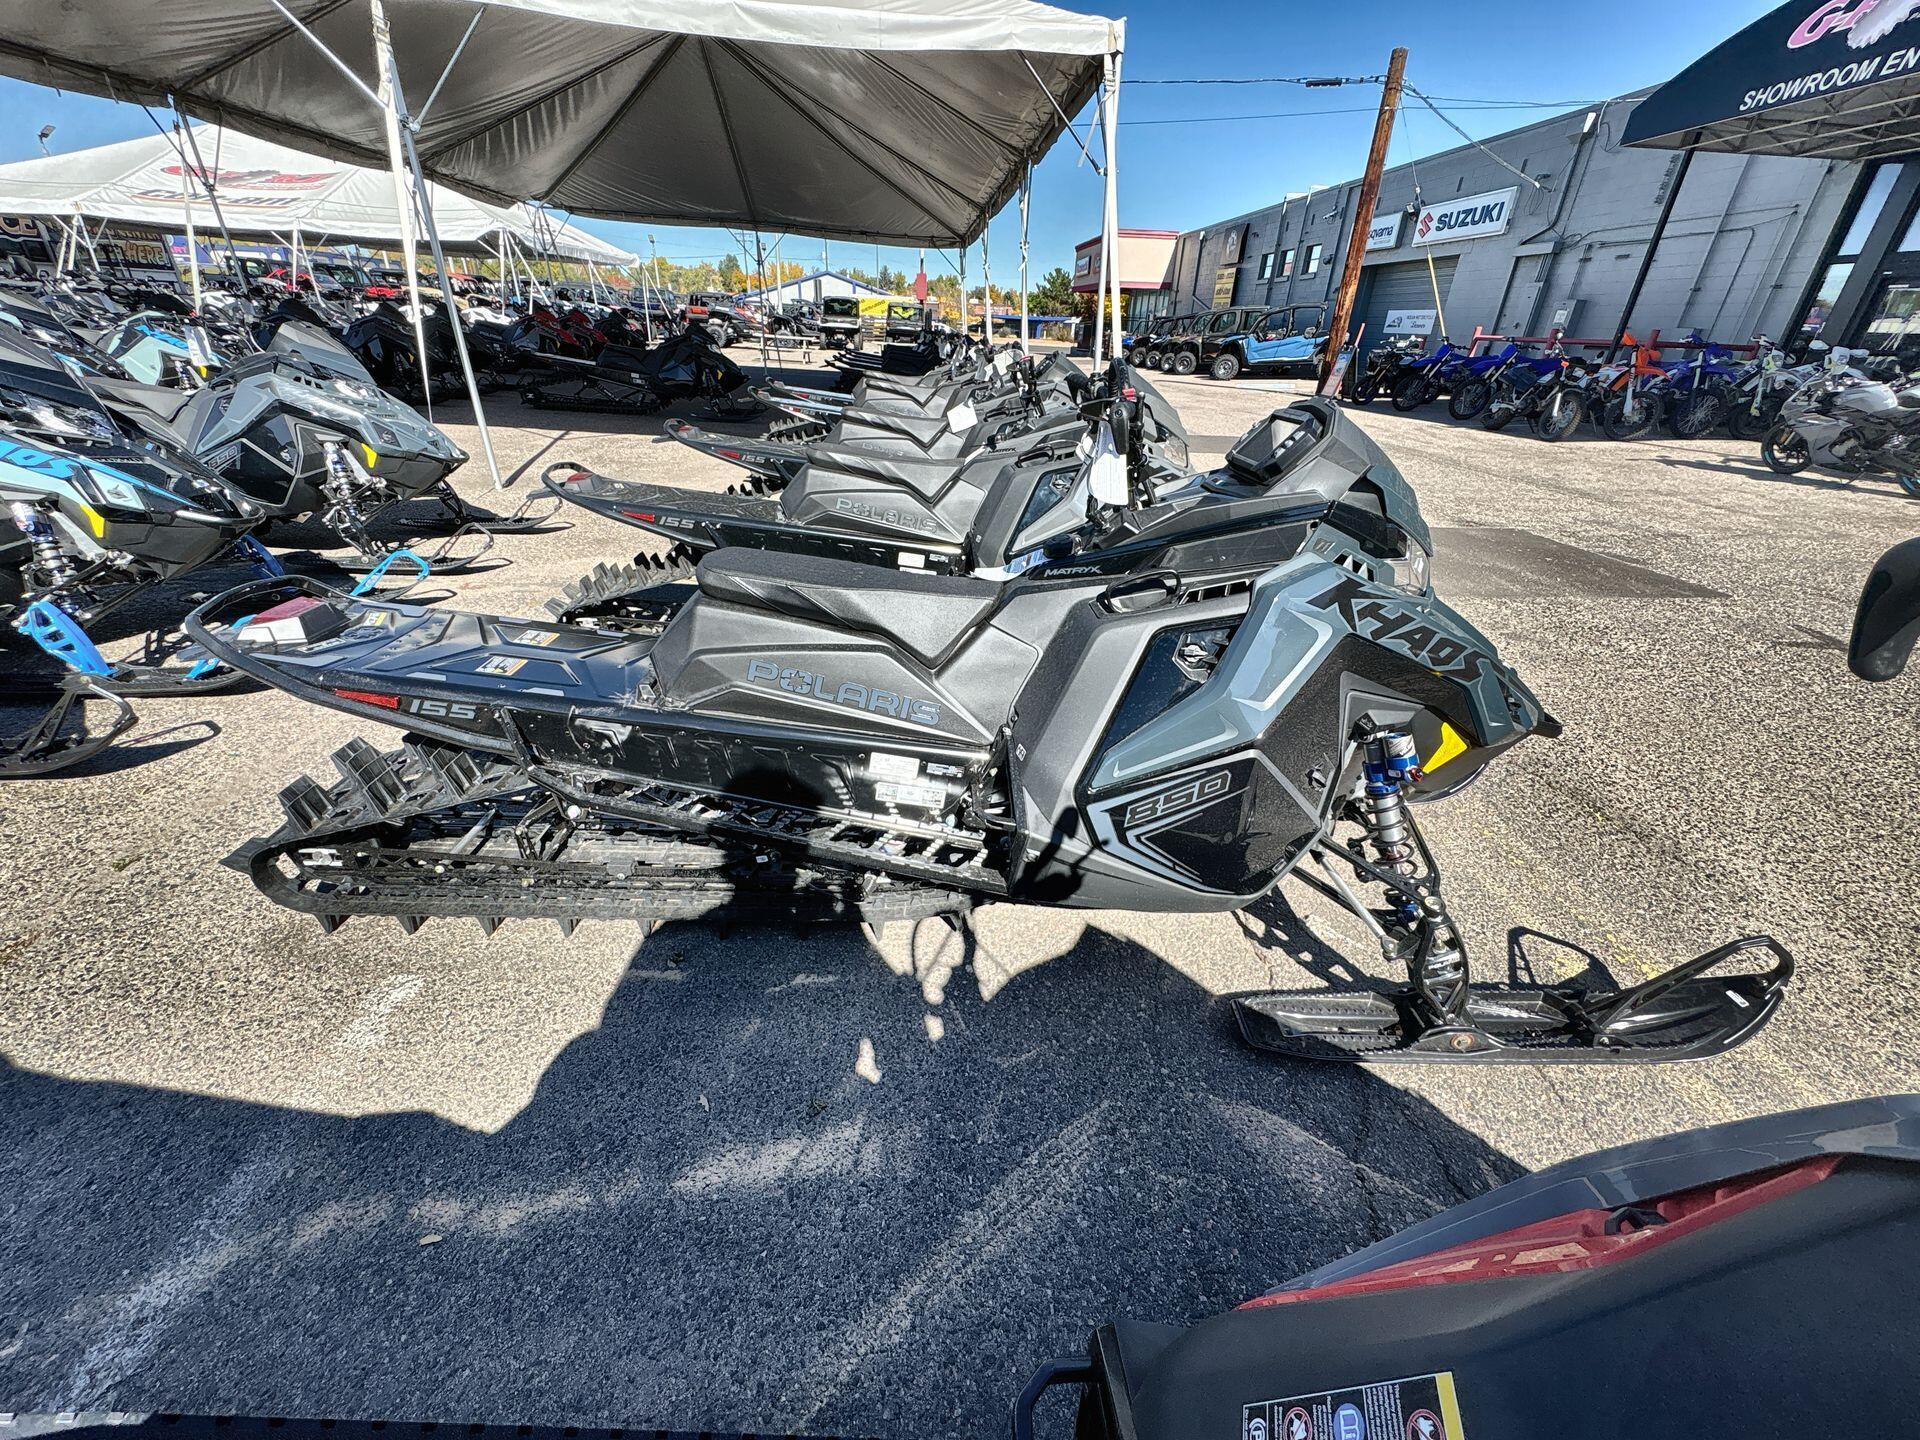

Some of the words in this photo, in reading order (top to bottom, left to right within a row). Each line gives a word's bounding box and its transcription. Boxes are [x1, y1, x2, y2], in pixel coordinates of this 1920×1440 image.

[1739, 56, 1882, 111] SHOWROOM
[1435, 202, 1505, 232] SUZUKI
[124, 241, 168, 266] HERE
[740, 454, 766, 464] 155
[658, 516, 696, 530] 155
[835, 497, 938, 534] POLARIS
[1044, 566, 1103, 578] MATRYX
[1306, 577, 1507, 684] KHAOS
[746, 659, 941, 726] POLARIS
[408, 698, 478, 721] 155
[1123, 769, 1232, 829] 850
